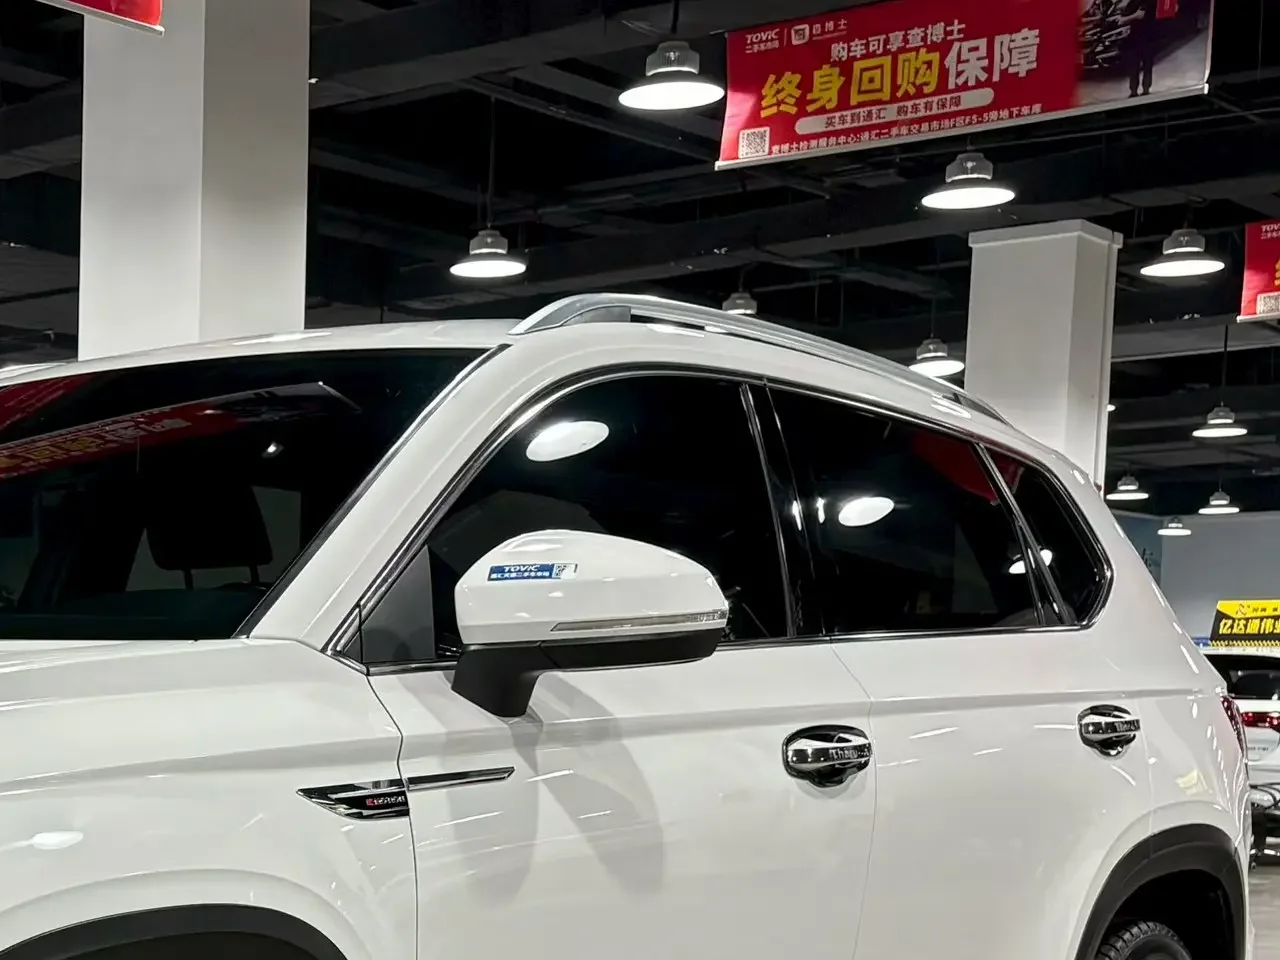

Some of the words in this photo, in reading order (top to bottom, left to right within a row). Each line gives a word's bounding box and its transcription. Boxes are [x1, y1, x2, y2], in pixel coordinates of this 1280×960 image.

[745, 29, 780, 44] TOVIC
[830, 19, 965, 62] 购车可享查博士
[760, 28, 1040, 118] 终身回购保障
[824, 107, 888, 129] 买车到通汇
[896, 95, 961, 118] 购车有保障
[503, 564, 540, 573] TOVIC
